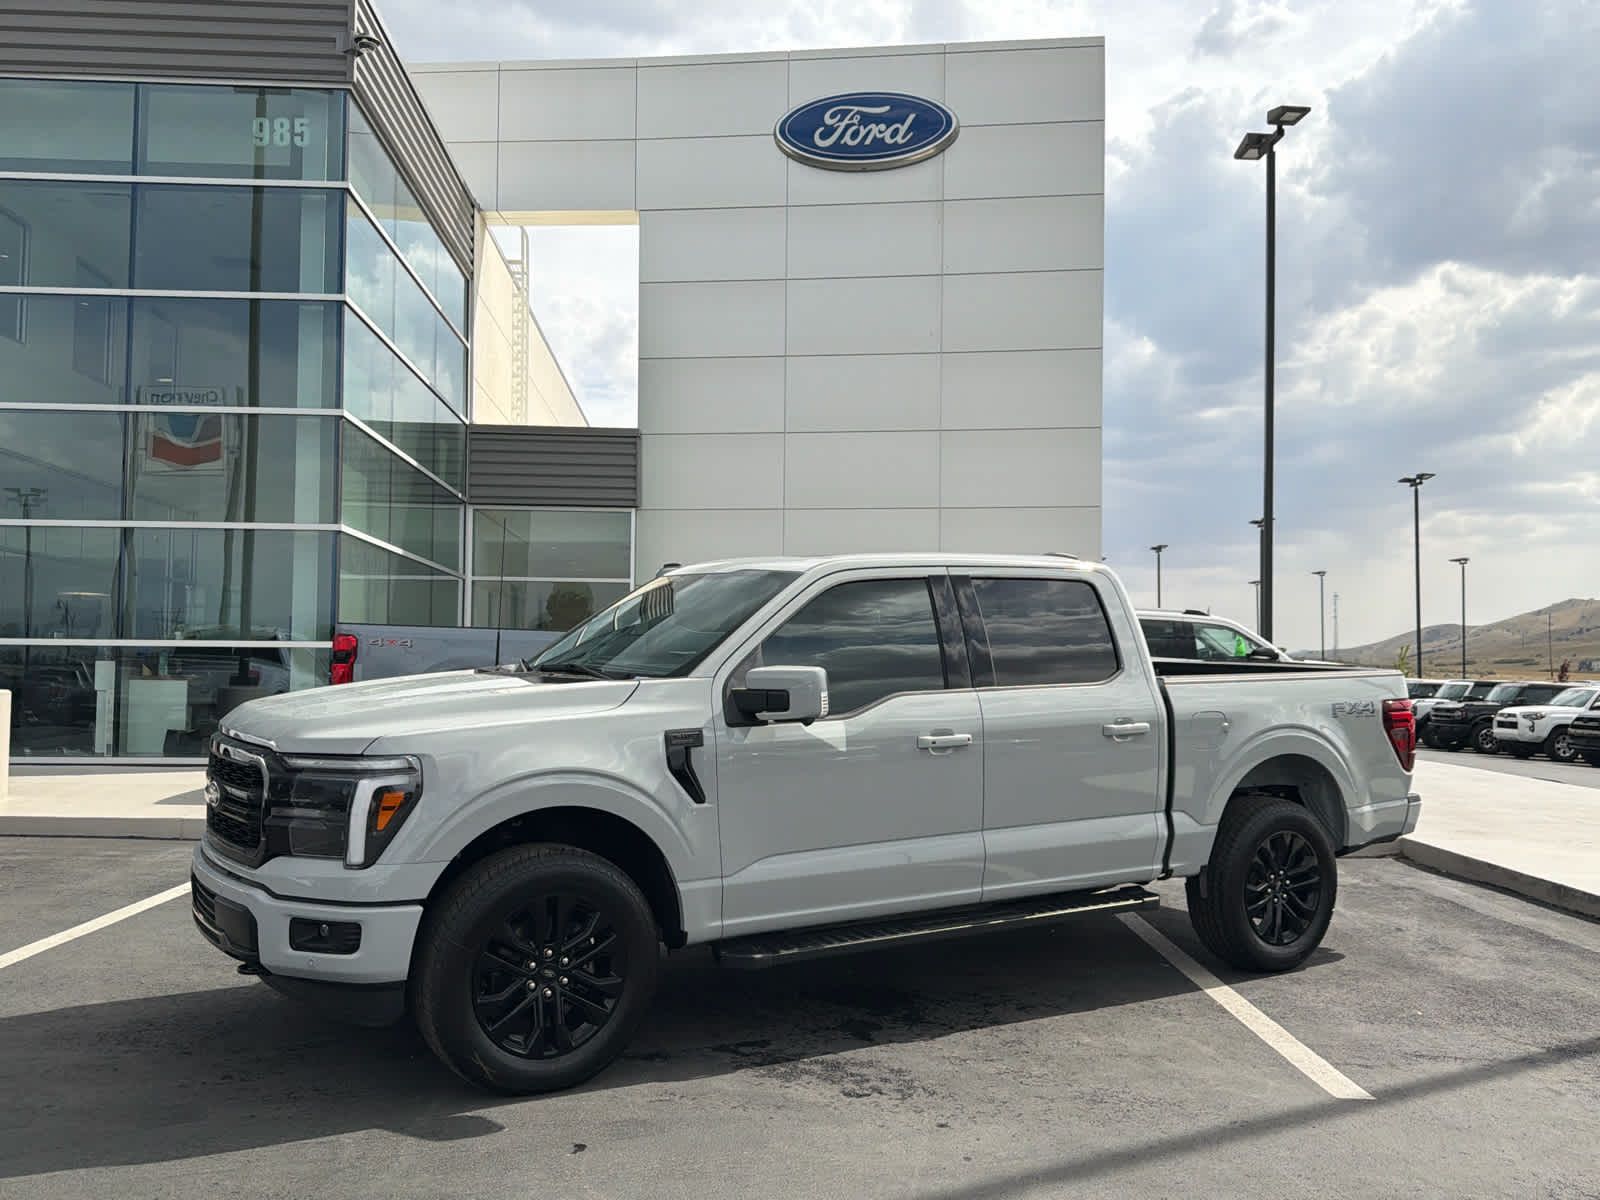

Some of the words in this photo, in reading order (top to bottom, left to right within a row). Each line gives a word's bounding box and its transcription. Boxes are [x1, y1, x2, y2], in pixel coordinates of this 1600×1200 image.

[253, 118, 311, 147] 985
[813, 105, 916, 148] Ford
[1331, 701, 1376, 718] FX4
